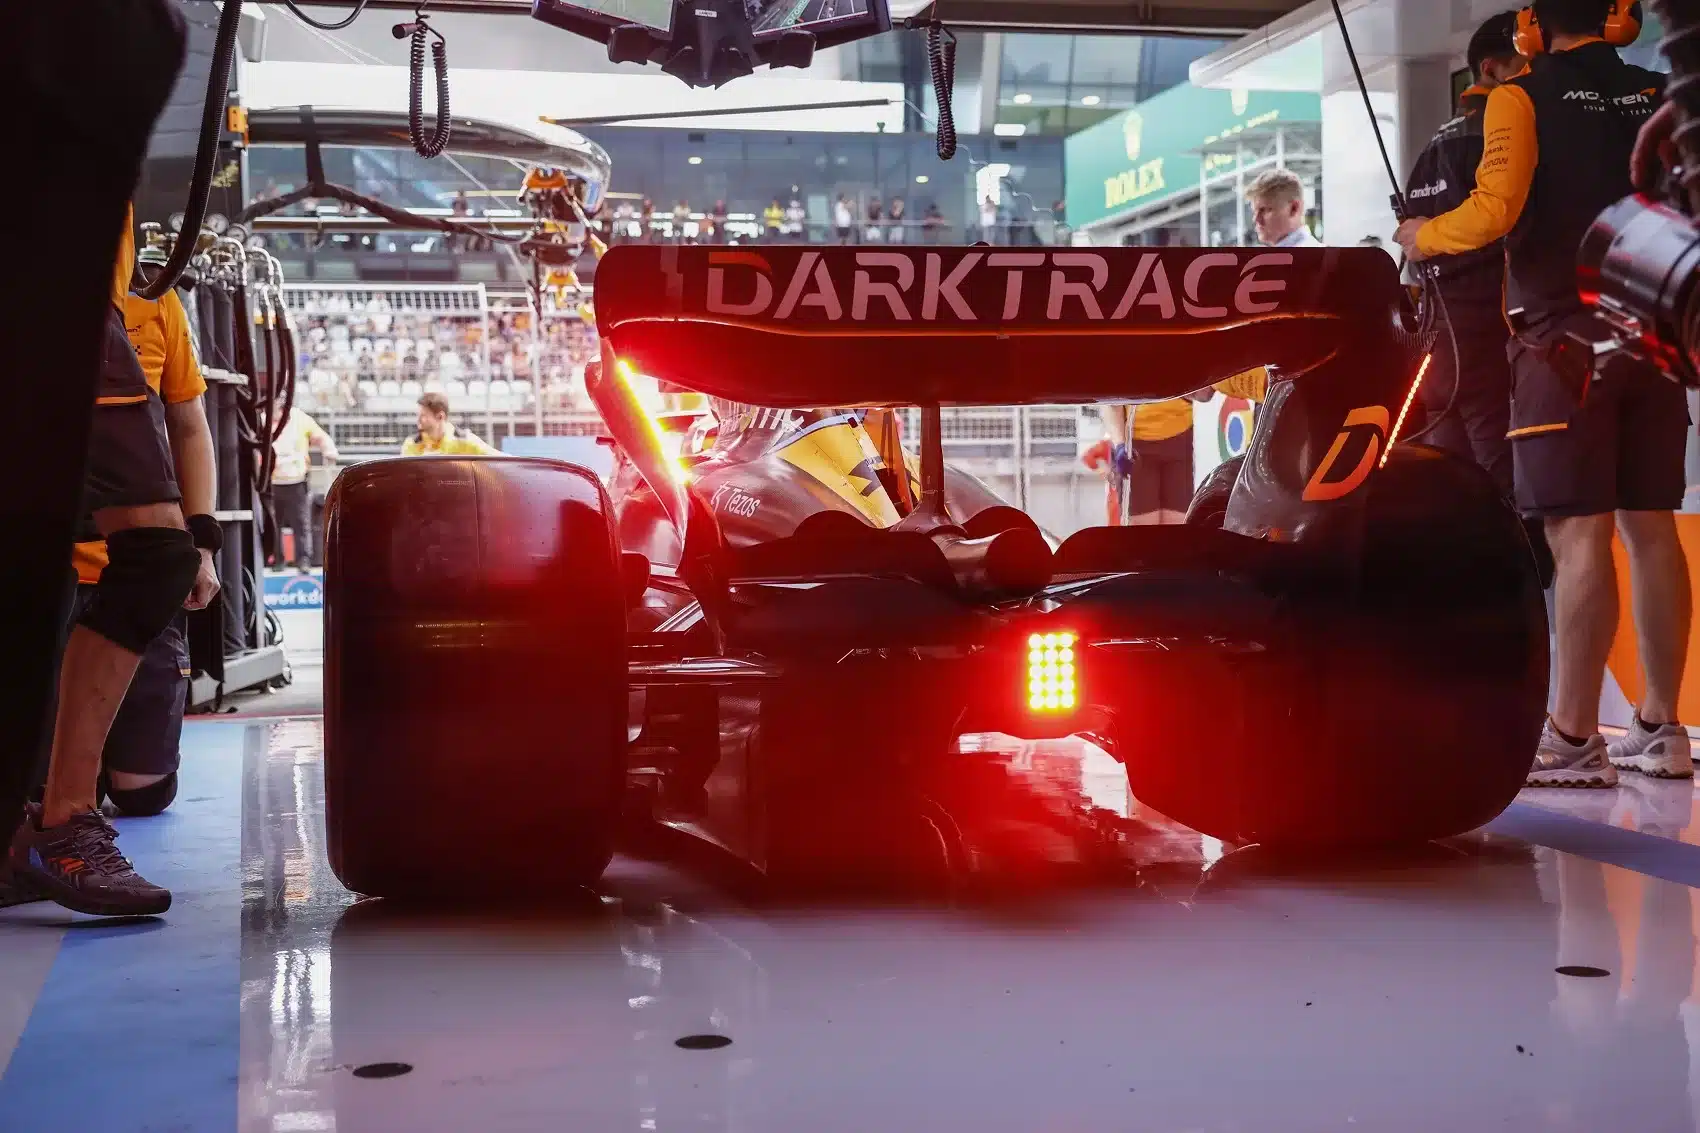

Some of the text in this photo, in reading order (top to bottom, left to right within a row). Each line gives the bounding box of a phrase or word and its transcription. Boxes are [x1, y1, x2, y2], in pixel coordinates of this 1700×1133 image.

[1562, 91, 1650, 106] Mcren
[1104, 157, 1164, 209] ROLEX
[706, 251, 1294, 321] DARKTRACE
[724, 487, 761, 518] Tezos
[263, 587, 324, 606] workd
